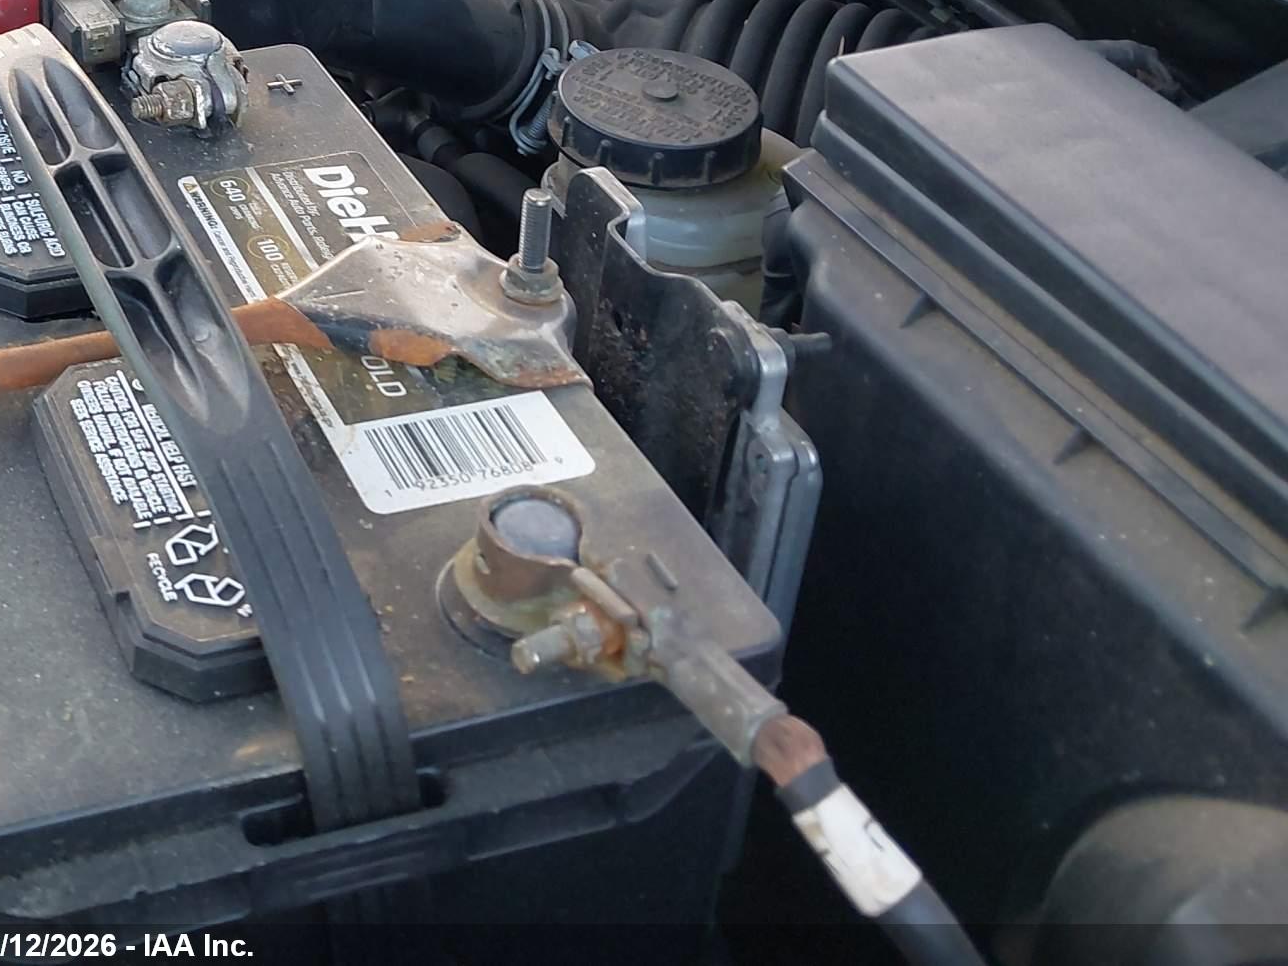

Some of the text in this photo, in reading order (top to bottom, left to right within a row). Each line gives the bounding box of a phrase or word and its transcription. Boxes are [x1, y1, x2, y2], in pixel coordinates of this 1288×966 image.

[11, 170, 28, 184] NO
[220, 180, 246, 202] 640
[282, 172, 315, 206] Distributed
[270, 173, 294, 199] Advance
[288, 200, 305, 215] Auto
[303, 165, 400, 242] DieH
[0, 204, 32, 253] BLINDNESS OR
[12, 201, 40, 240] CAN CAUSE
[25, 199, 66, 257] SULFURIC ACID
[257, 239, 284, 261] 100
[361, 355, 408, 397] OLD
[70, 399, 90, 420] SEEK
[122, 411, 140, 428] FOR
[79, 420, 106, 453] SERVICE
[93, 381, 117, 412] FOLLOW
[108, 413, 144, 468] INSTRUCTIONS
[139, 479, 166, 513] VEHICLE
[130, 429, 151, 450] SAFE
[160, 441, 185, 463] HELP
[113, 458, 132, 475] NOT
[172, 464, 197, 487] FAST
[414, 471, 472, 492] 92350
[476, 460, 536, 480] 76808
[121, 478, 153, 520] AVAILABLE
[151, 473, 182, 514] STARTING
[147, 553, 178, 601] RECYCLE
